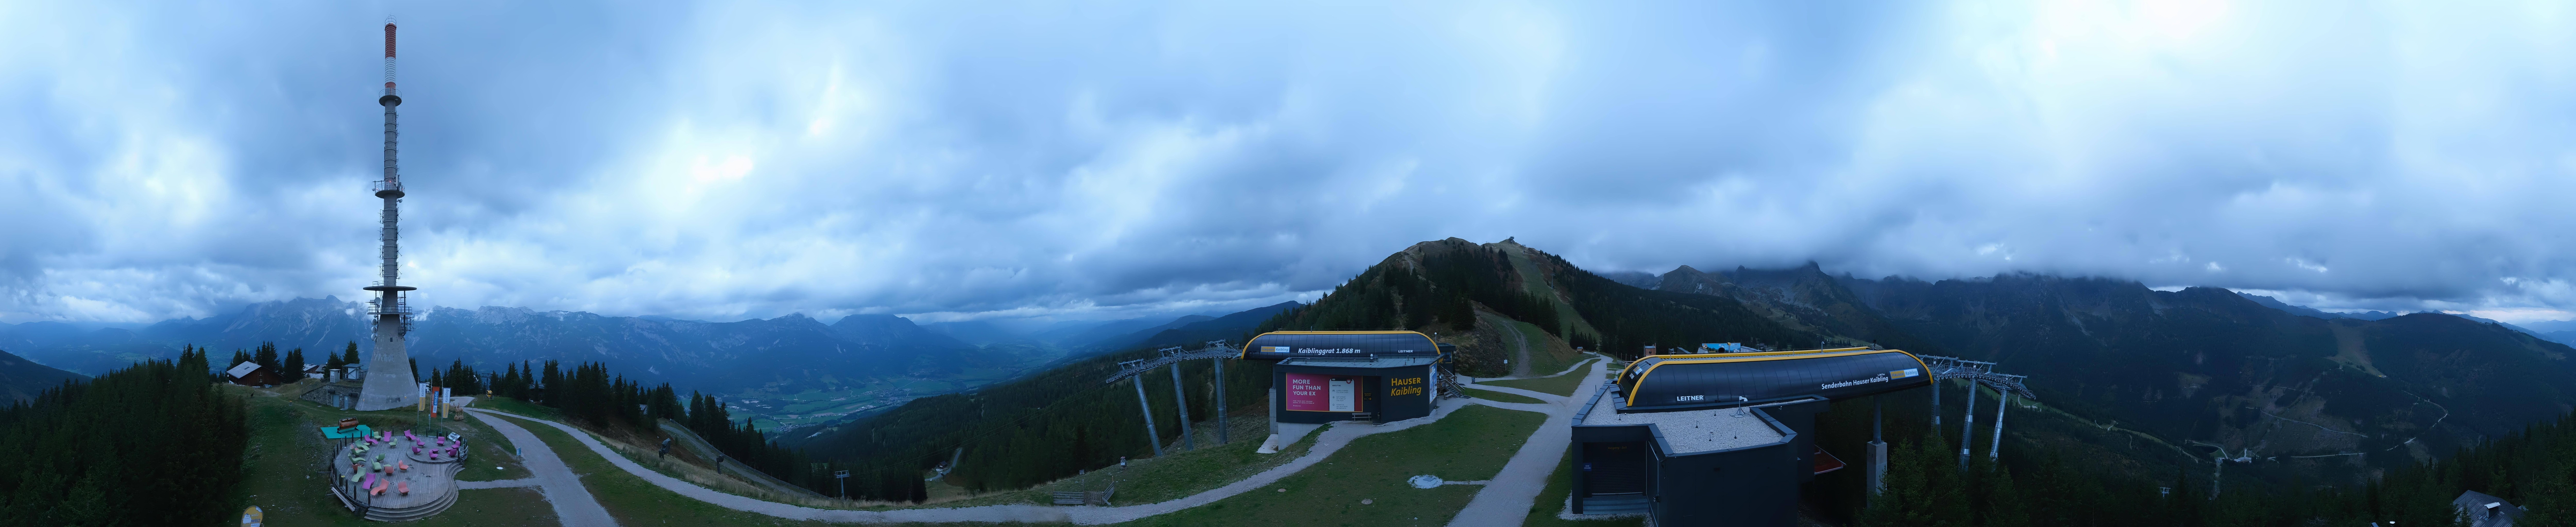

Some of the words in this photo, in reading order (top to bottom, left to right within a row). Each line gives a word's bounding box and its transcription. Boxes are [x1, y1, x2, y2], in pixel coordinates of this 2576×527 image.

[1391, 378, 1421, 386] HAUSER
[1822, 380, 1852, 389] Senderbahn
[1391, 386, 1421, 396] Kaibling
